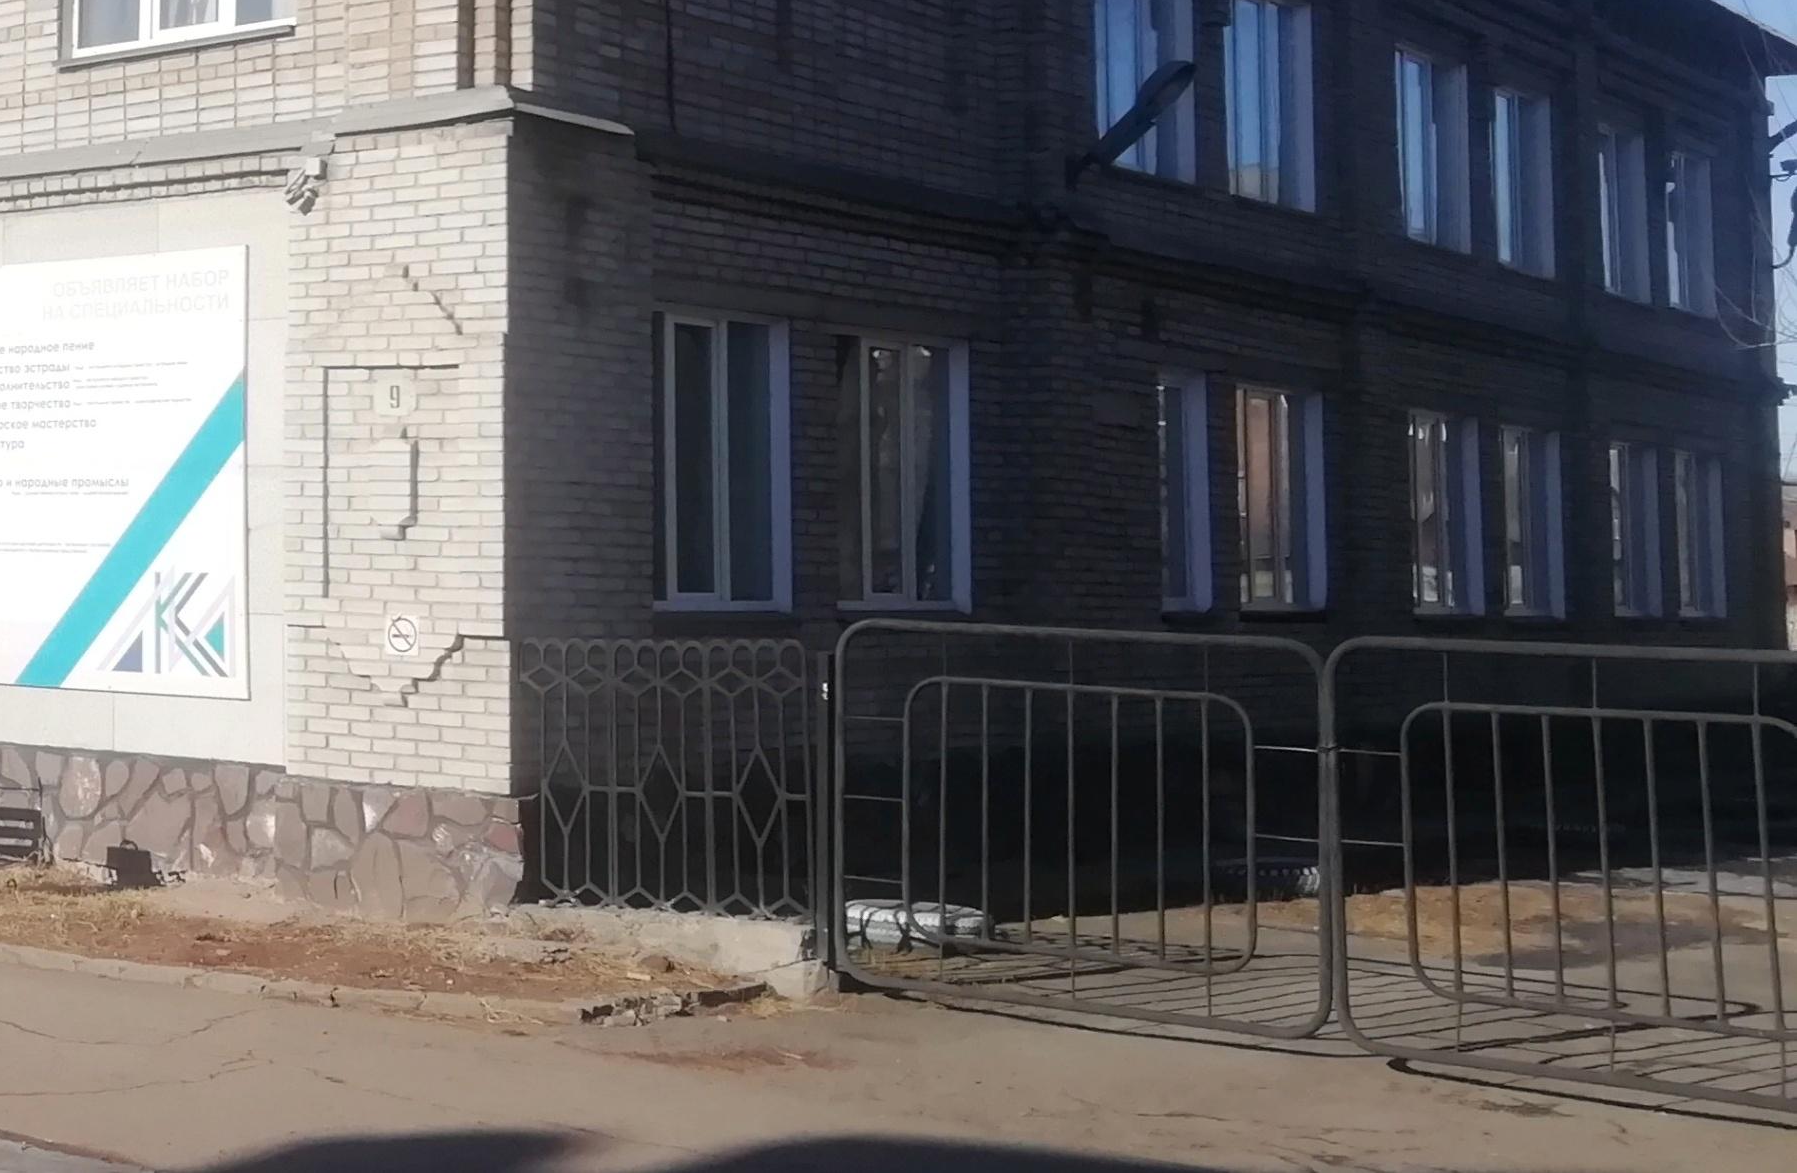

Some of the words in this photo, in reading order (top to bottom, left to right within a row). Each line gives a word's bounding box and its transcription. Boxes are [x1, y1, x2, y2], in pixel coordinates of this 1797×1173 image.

[166, 269, 230, 291] НАБОР
[8, 343, 60, 356] народное
[24, 363, 70, 375] эстрады
[389, 385, 400, 408] 9
[11, 400, 71, 413] творчество
[31, 419, 97, 431] мастерство
[15, 478, 68, 490] народные
[71, 477, 130, 489] промыслы
